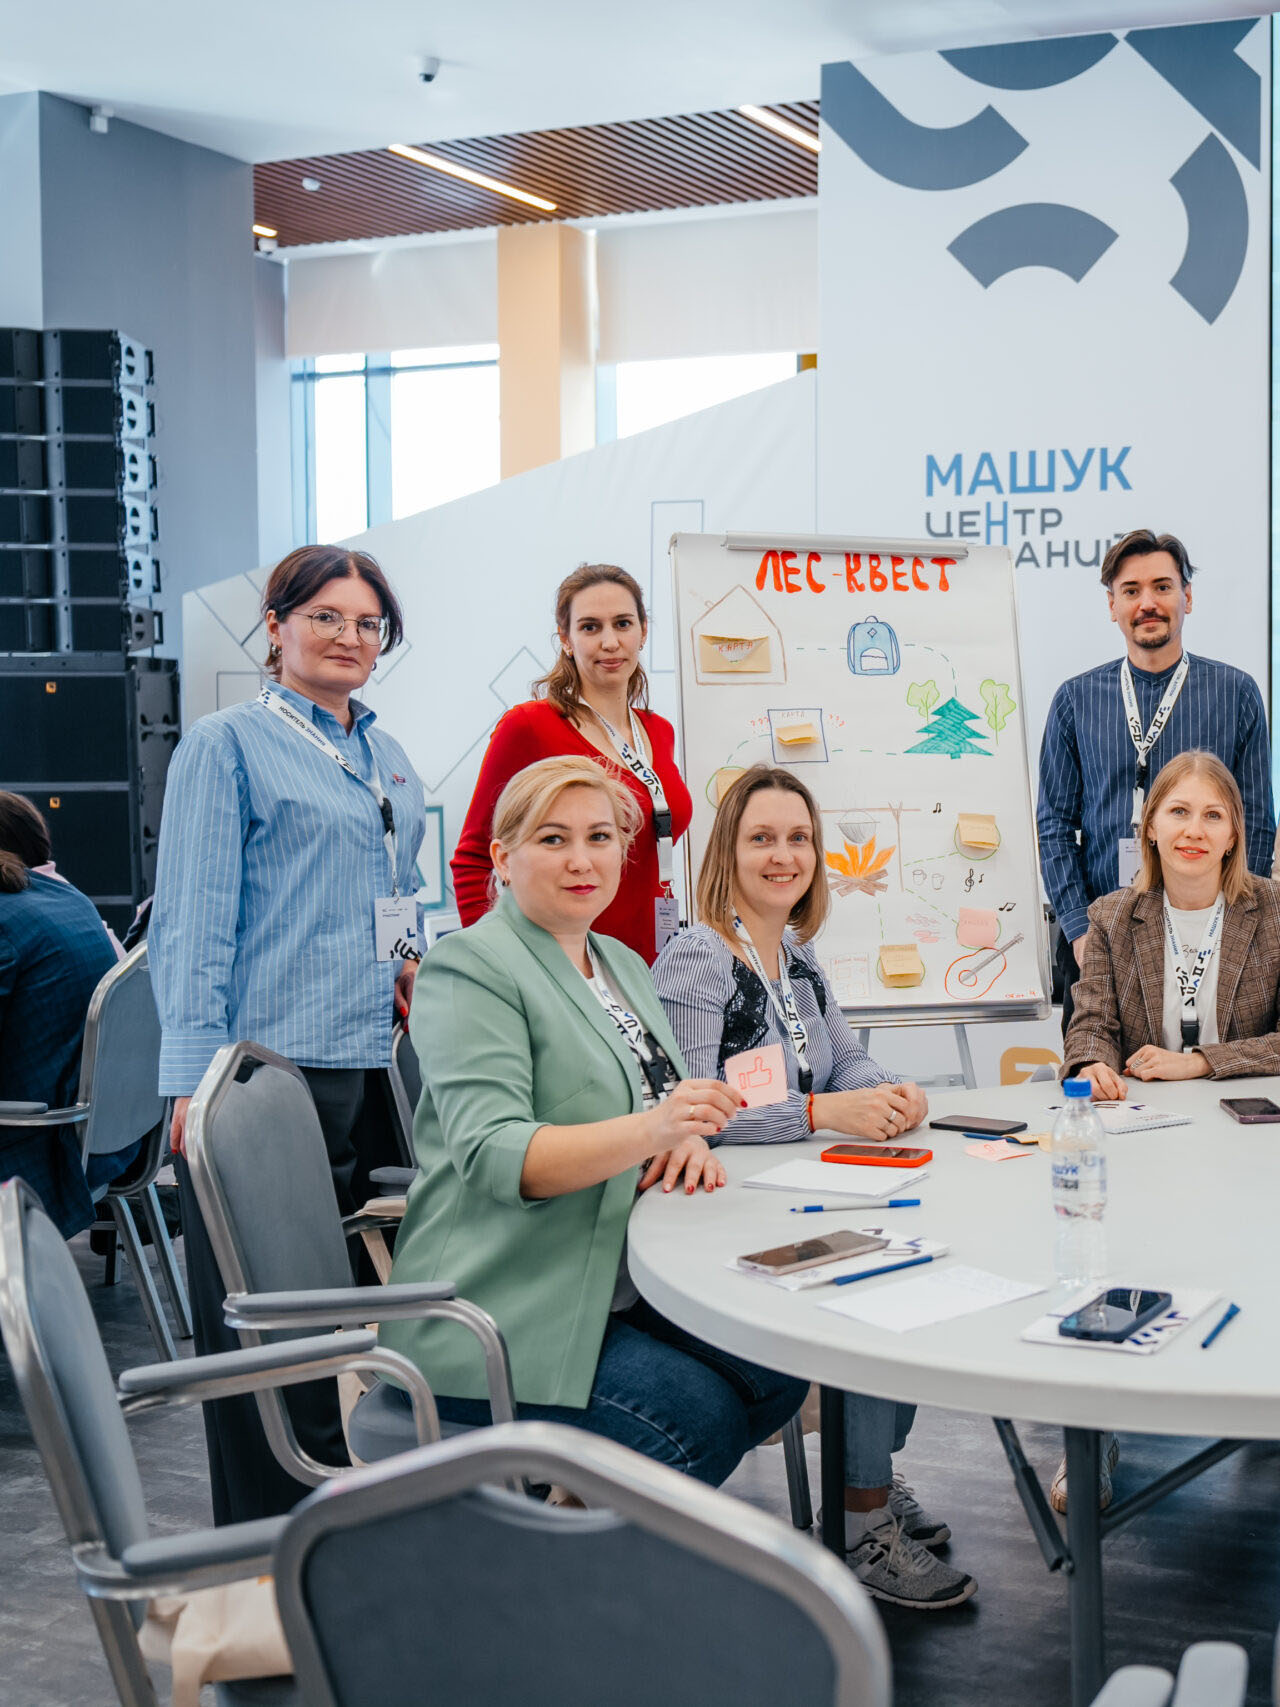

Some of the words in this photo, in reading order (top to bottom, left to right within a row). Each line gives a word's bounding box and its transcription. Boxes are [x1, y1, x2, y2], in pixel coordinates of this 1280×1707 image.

[926, 446, 1132, 497] МАШУК
[925, 501, 1063, 546] ЦЕНТР
[756, 550, 957, 593] ЛЕС-КВЕСТ
[718, 641, 753, 652] КАРТА
[278, 705, 306, 729] НОСИТЕЛЬ
